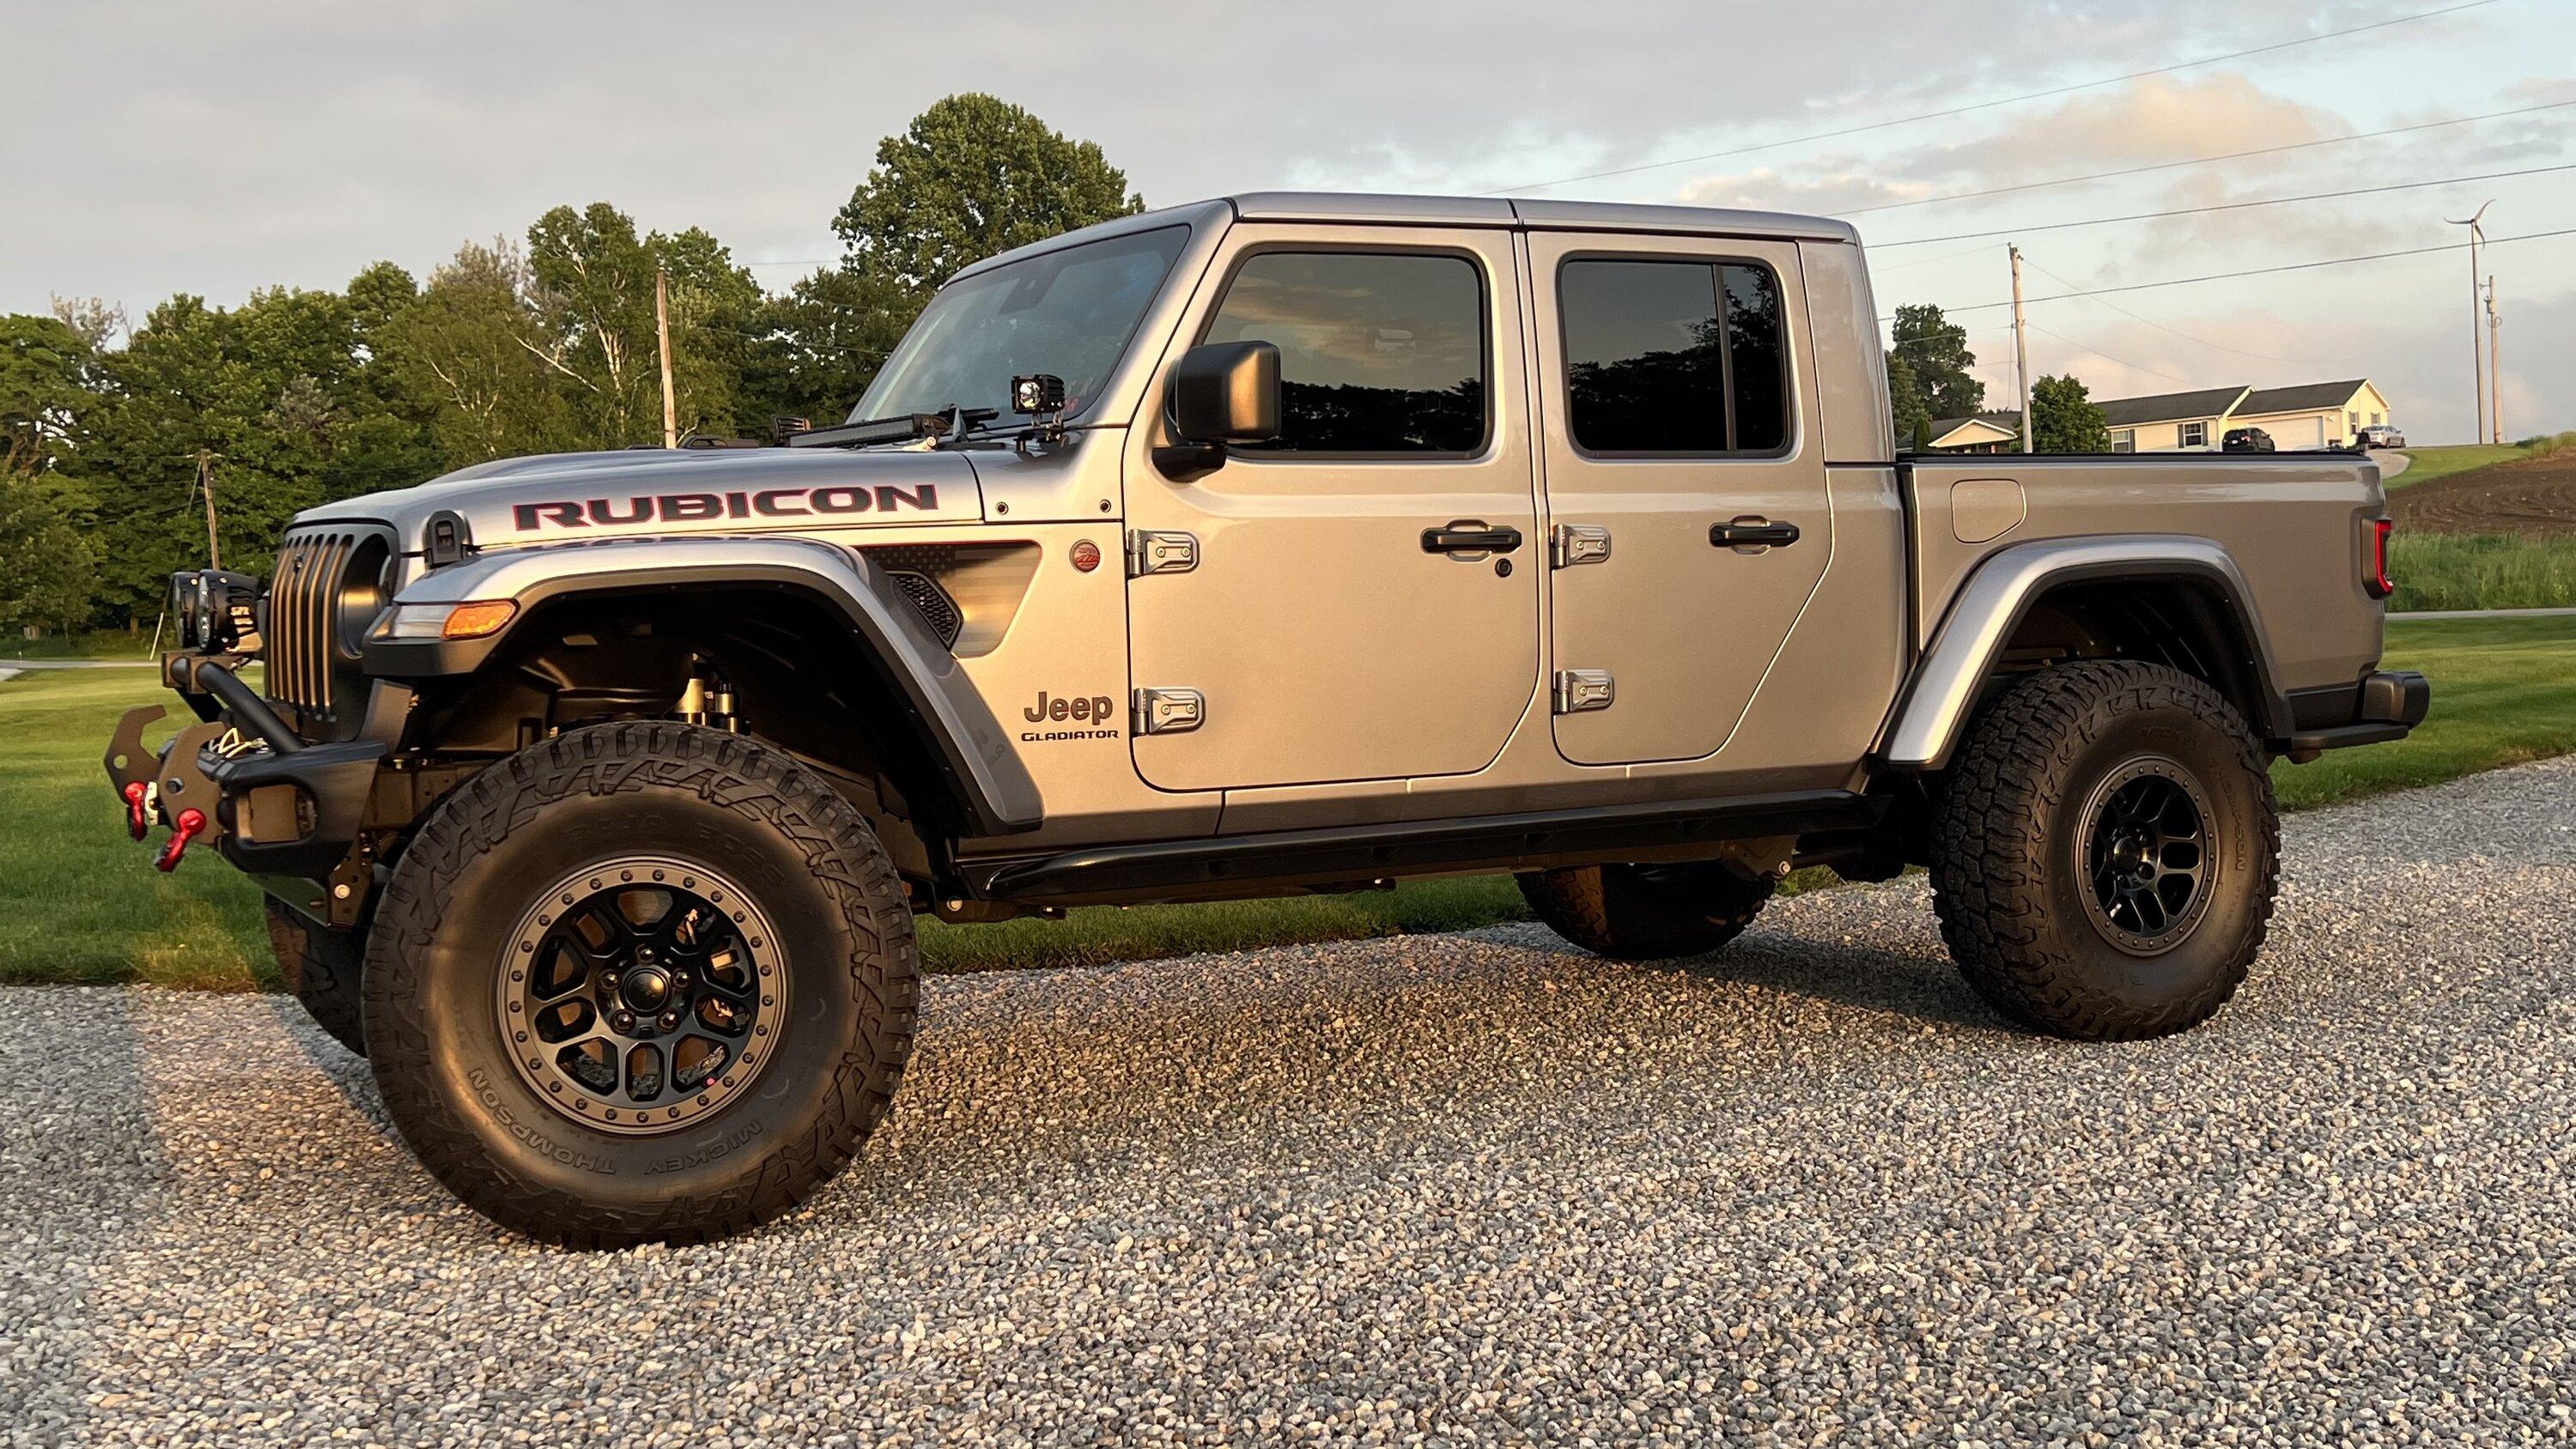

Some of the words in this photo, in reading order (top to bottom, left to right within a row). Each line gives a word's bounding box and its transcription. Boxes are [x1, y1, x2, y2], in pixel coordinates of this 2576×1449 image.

[512, 483, 939, 530] RUBICON
[1024, 691, 1113, 725] Jeep
[1021, 730, 1119, 742] GLADIATOR
[468, 1066, 617, 1176] THOMPSON
[643, 1119, 762, 1176] MICKEY
